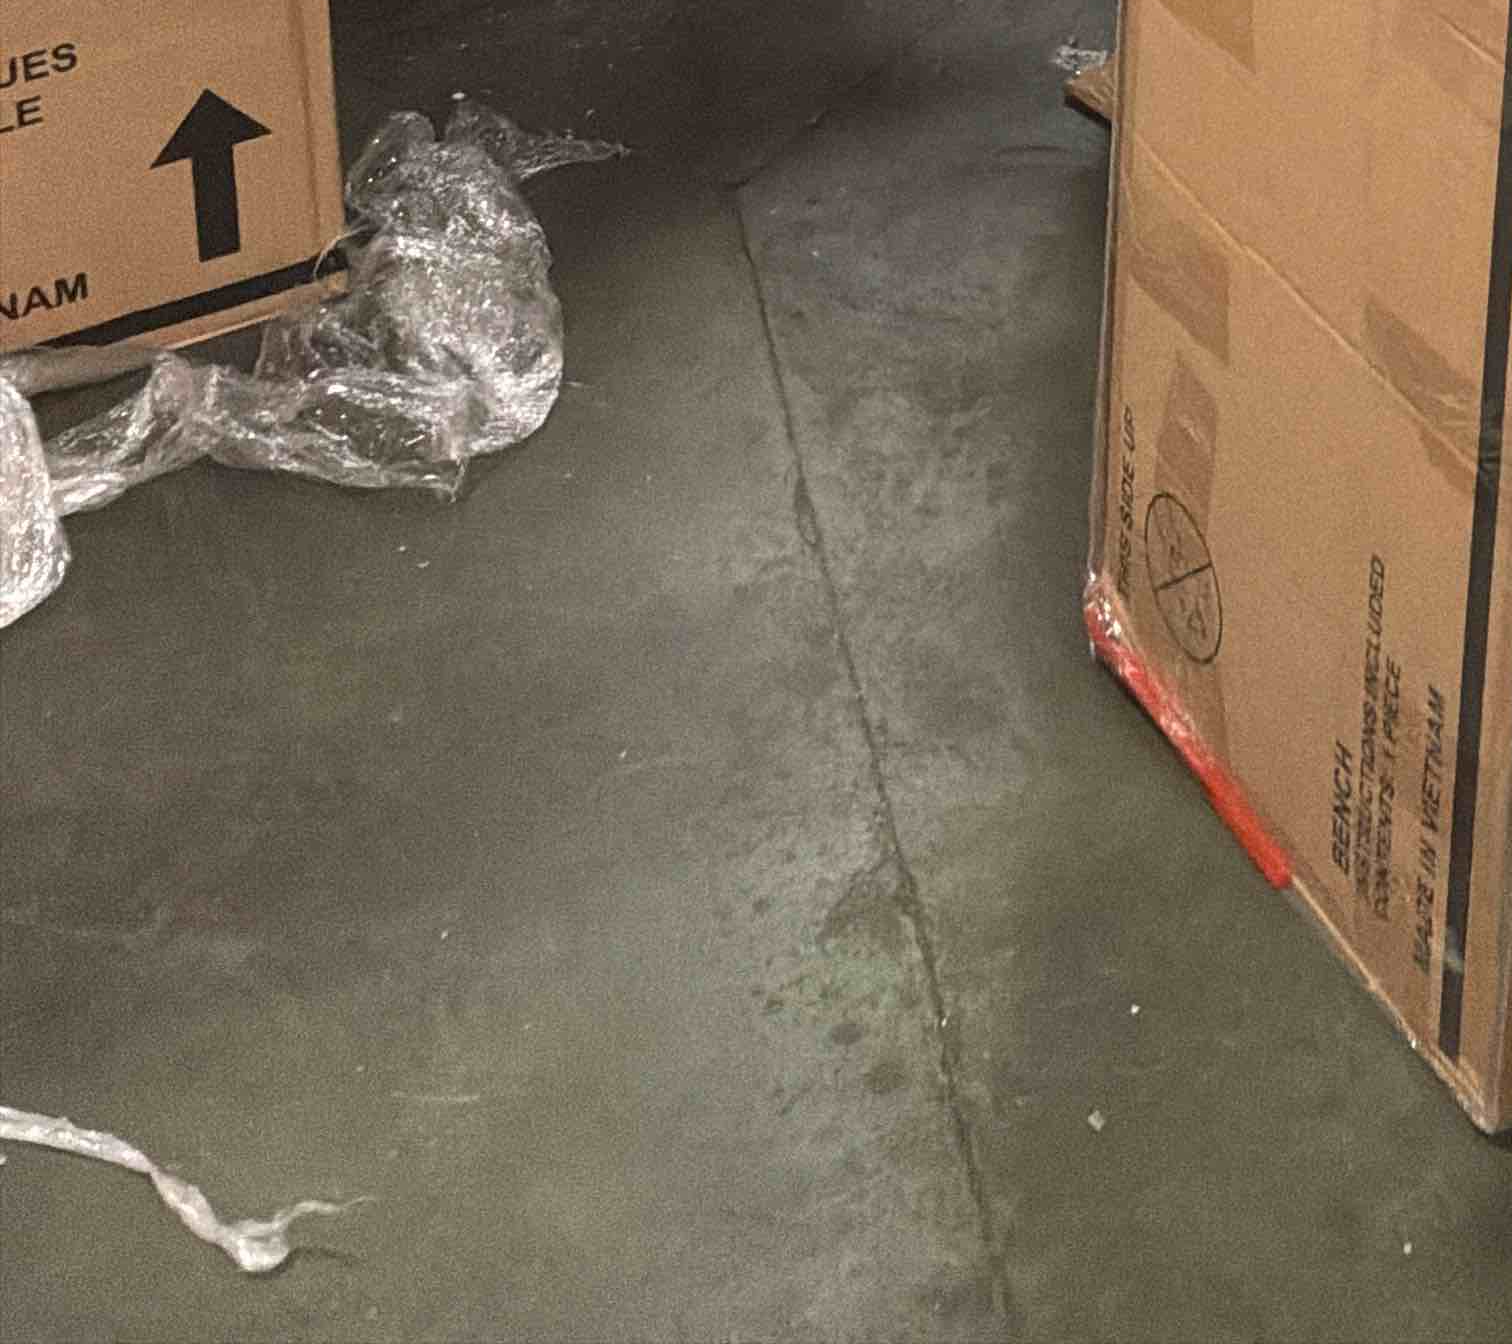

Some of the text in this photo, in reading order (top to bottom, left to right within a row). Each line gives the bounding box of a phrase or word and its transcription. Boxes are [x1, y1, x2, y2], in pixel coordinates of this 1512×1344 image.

[1121, 405, 1135, 451] UP
[1120, 455, 1134, 530] SIDE
[1353, 553, 1385, 902] INSTRUCTIONS INCLUDED
[1382, 654, 1401, 742] PIECE
[1332, 740, 1352, 875] BENCH
[1413, 683, 1444, 975] MADE IN VIETNAM
